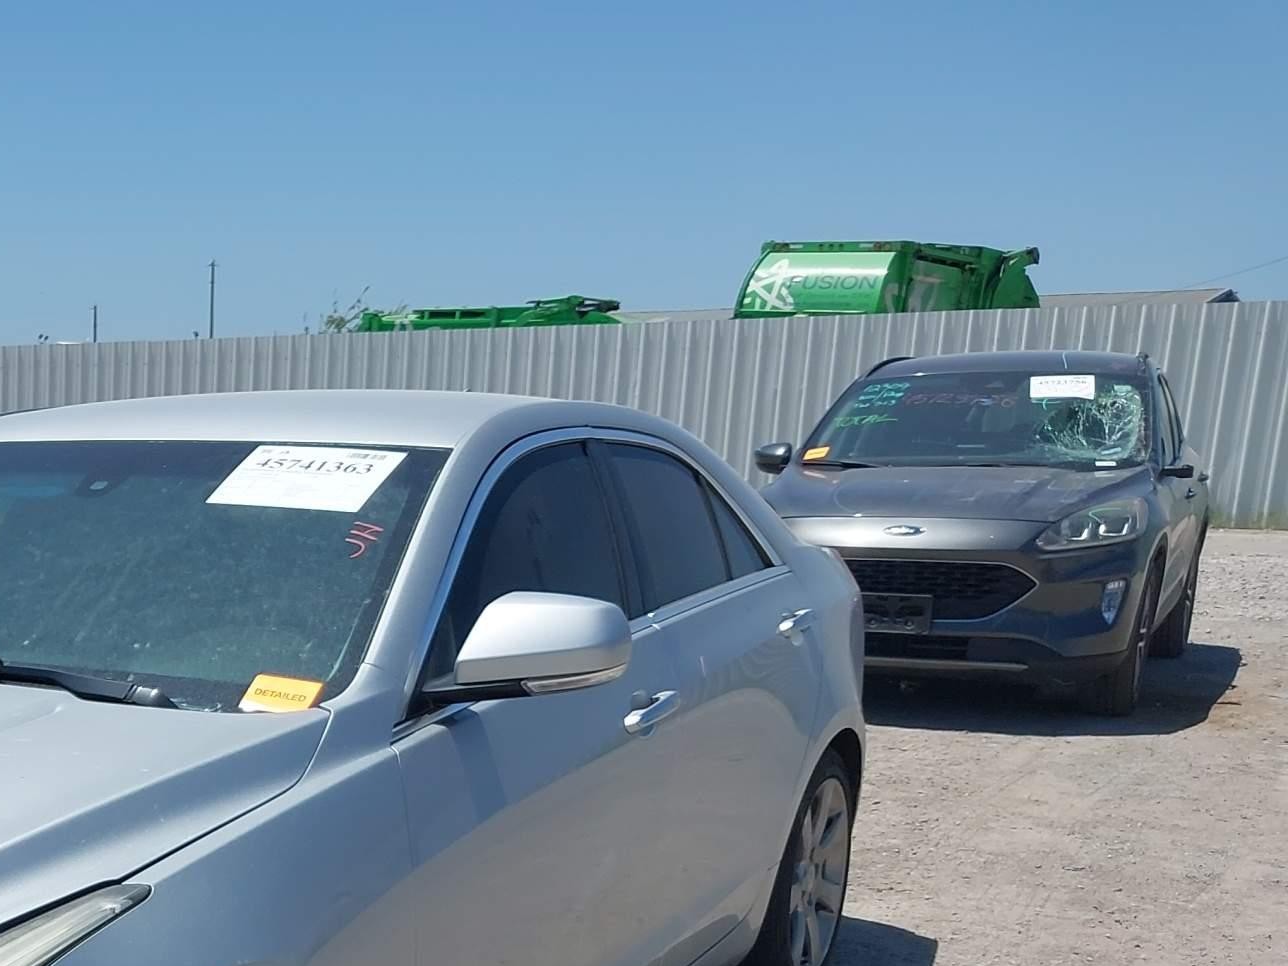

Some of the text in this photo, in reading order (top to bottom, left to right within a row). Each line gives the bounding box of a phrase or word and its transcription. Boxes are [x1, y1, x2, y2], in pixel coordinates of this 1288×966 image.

[789, 275, 879, 290] FUSION
[255, 458, 375, 475] 45741363
[254, 687, 307, 702] DETAILED
